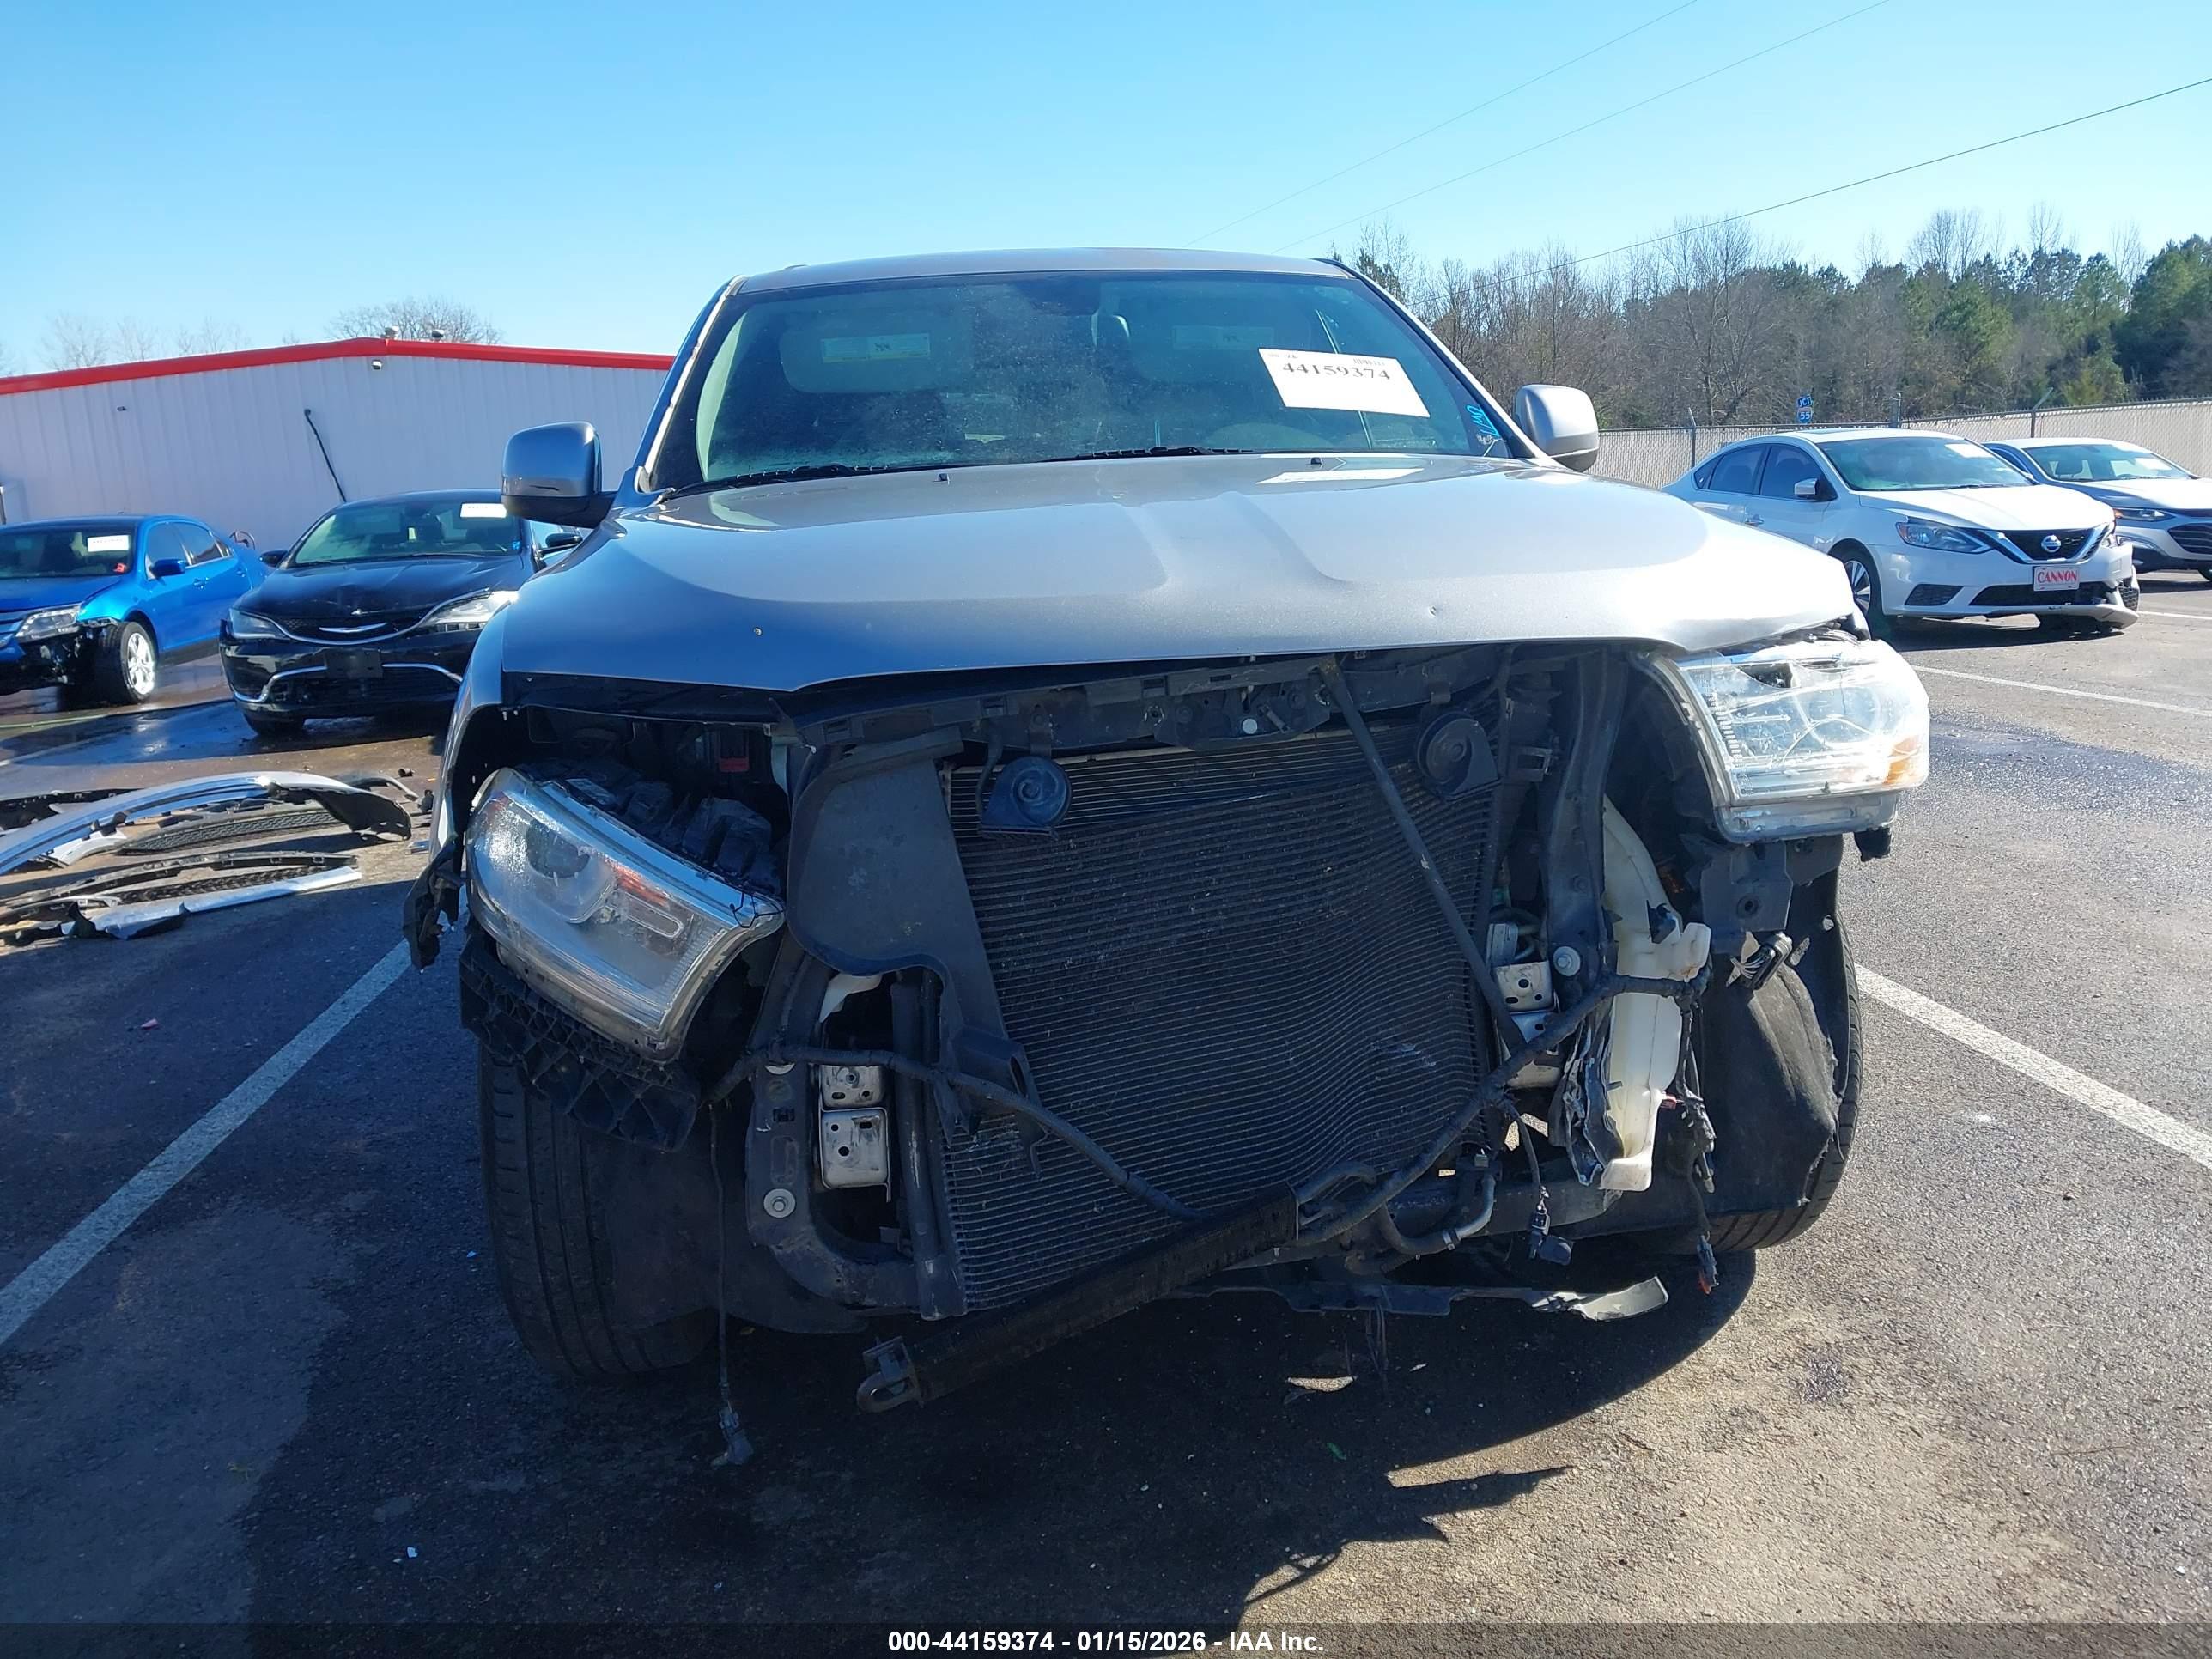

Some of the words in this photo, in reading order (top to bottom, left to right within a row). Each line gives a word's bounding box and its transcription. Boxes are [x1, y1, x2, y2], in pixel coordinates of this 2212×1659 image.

[1283, 362, 1390, 380] 44159374
[1799, 397, 1811, 407] JCT
[2037, 570, 2078, 584] CANNON
